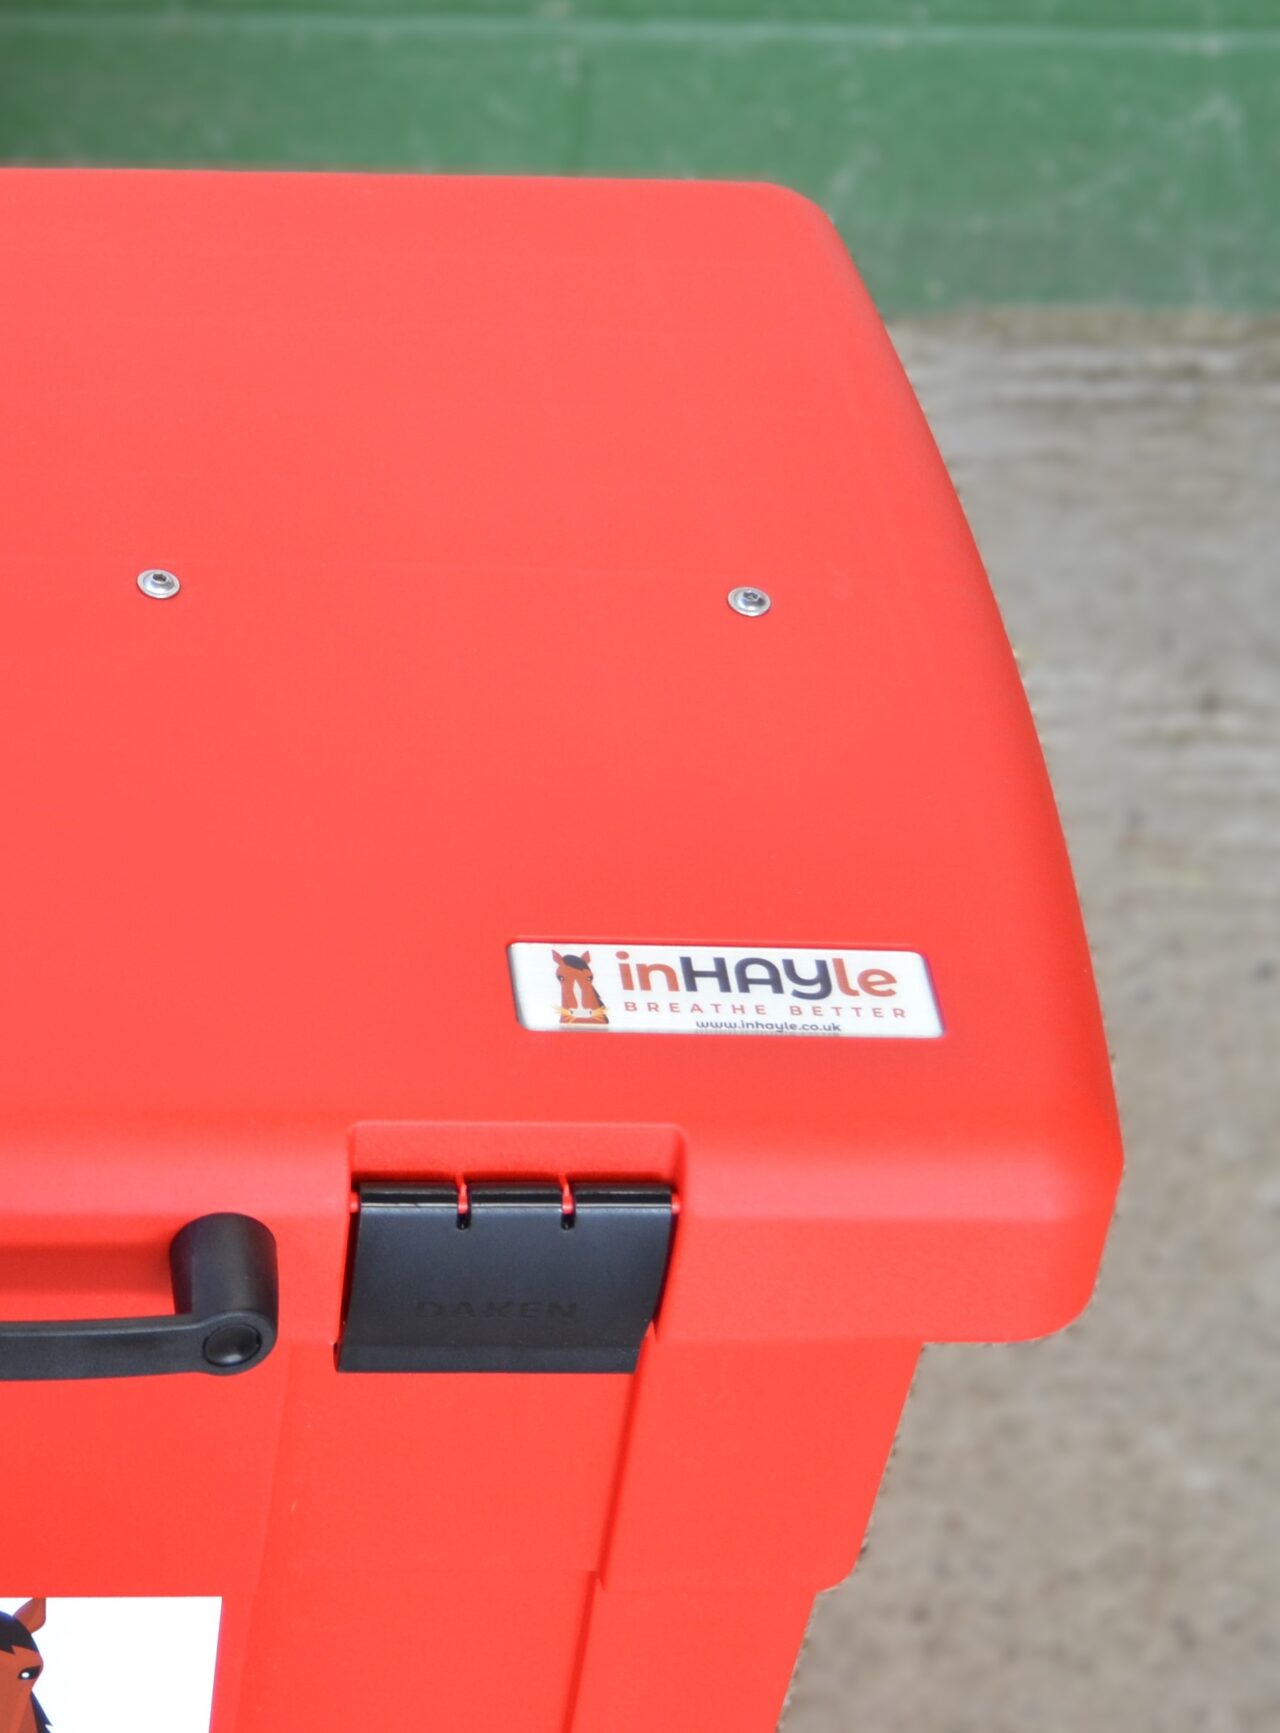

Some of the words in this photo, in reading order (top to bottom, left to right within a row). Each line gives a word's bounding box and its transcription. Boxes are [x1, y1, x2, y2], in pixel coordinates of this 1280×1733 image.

[623, 1001, 767, 1016] BREATHE
[789, 1004, 907, 1019] BETTER
[695, 1018, 841, 1033] www.inhayle.co.uk
[415, 1302, 578, 1319] DAKEN
